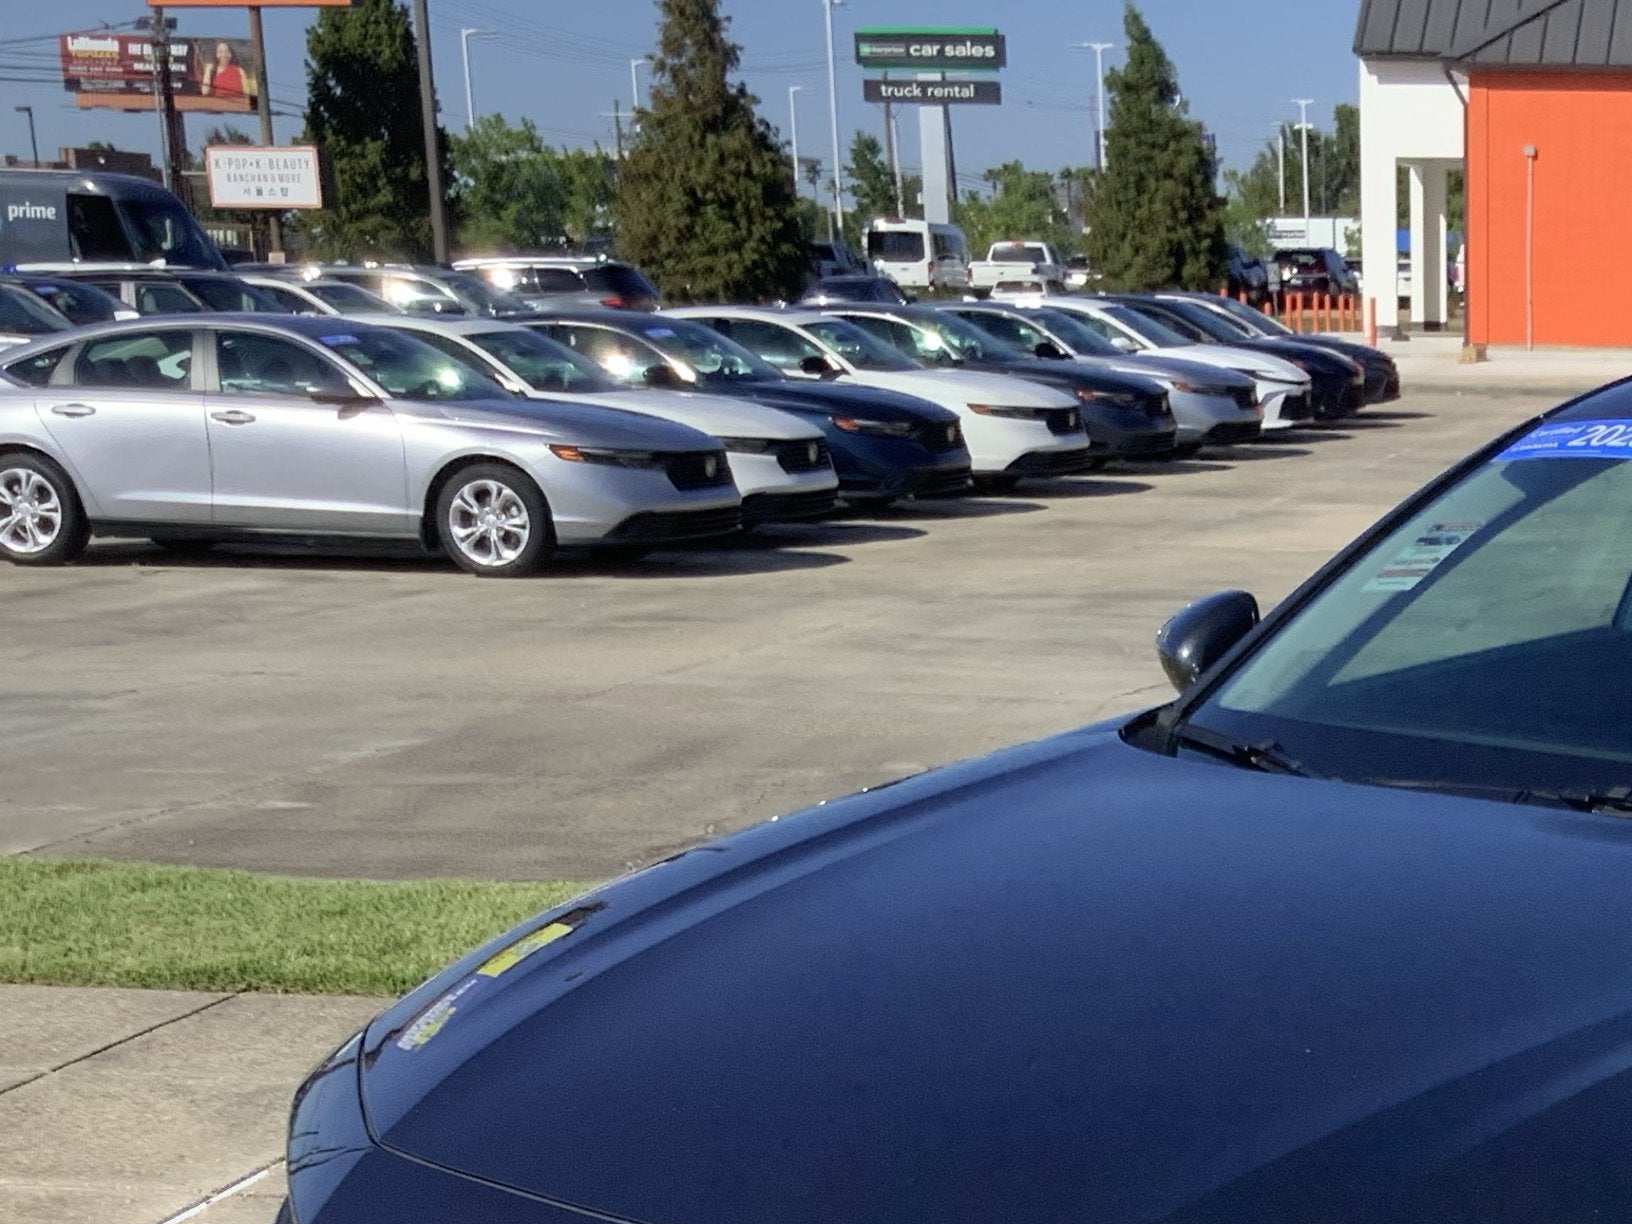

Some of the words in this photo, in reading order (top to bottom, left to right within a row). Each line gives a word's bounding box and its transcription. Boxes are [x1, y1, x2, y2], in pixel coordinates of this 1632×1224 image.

[909, 43, 940, 57] car
[944, 41, 995, 58] sales
[880, 83, 922, 98] truck
[927, 84, 974, 98] rental
[8, 201, 56, 222] prime
